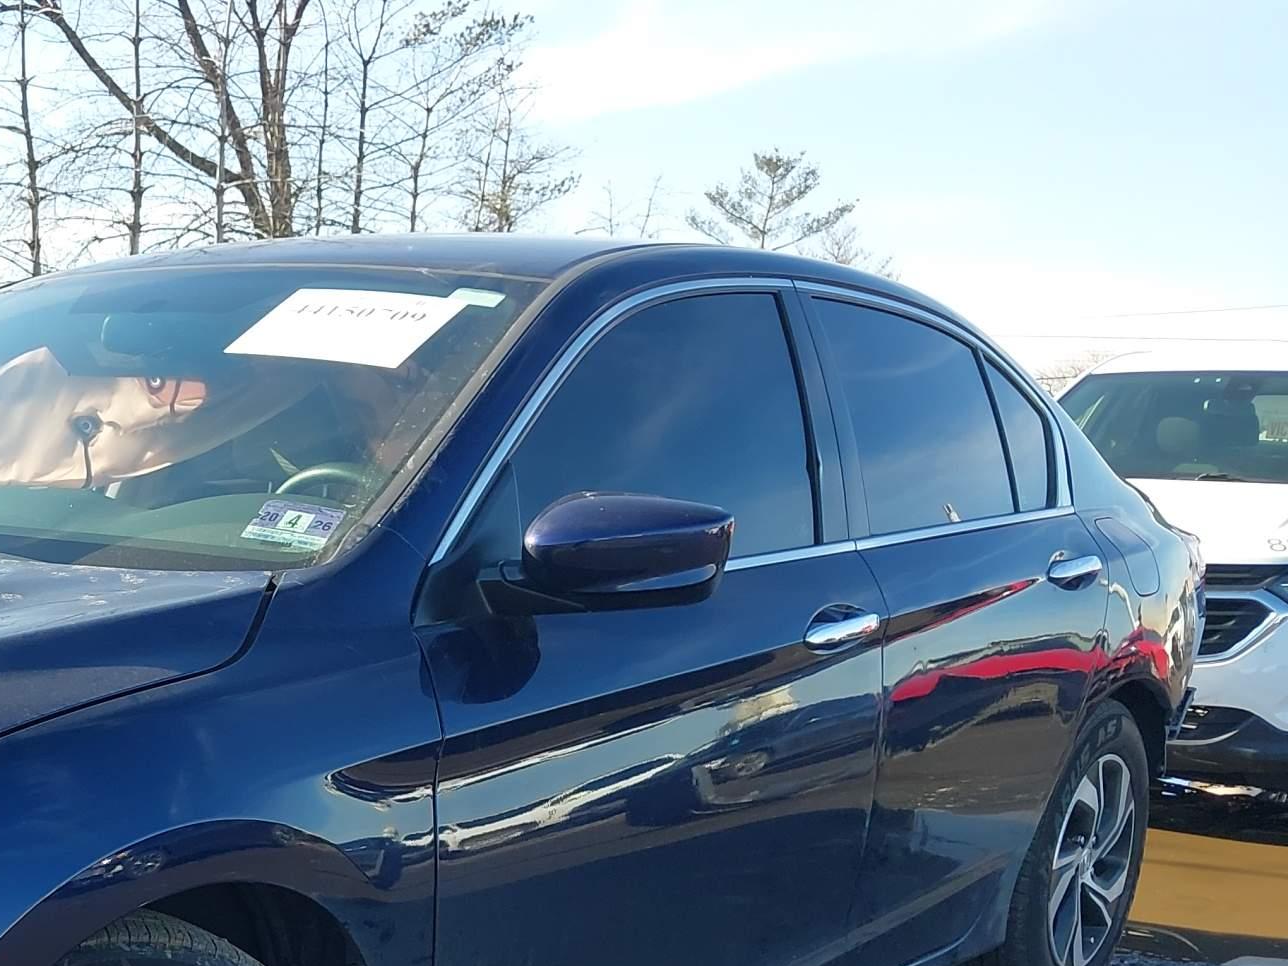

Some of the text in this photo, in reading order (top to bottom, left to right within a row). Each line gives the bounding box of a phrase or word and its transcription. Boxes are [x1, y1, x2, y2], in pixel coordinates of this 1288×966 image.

[260, 511, 333, 531] 20 4 26
